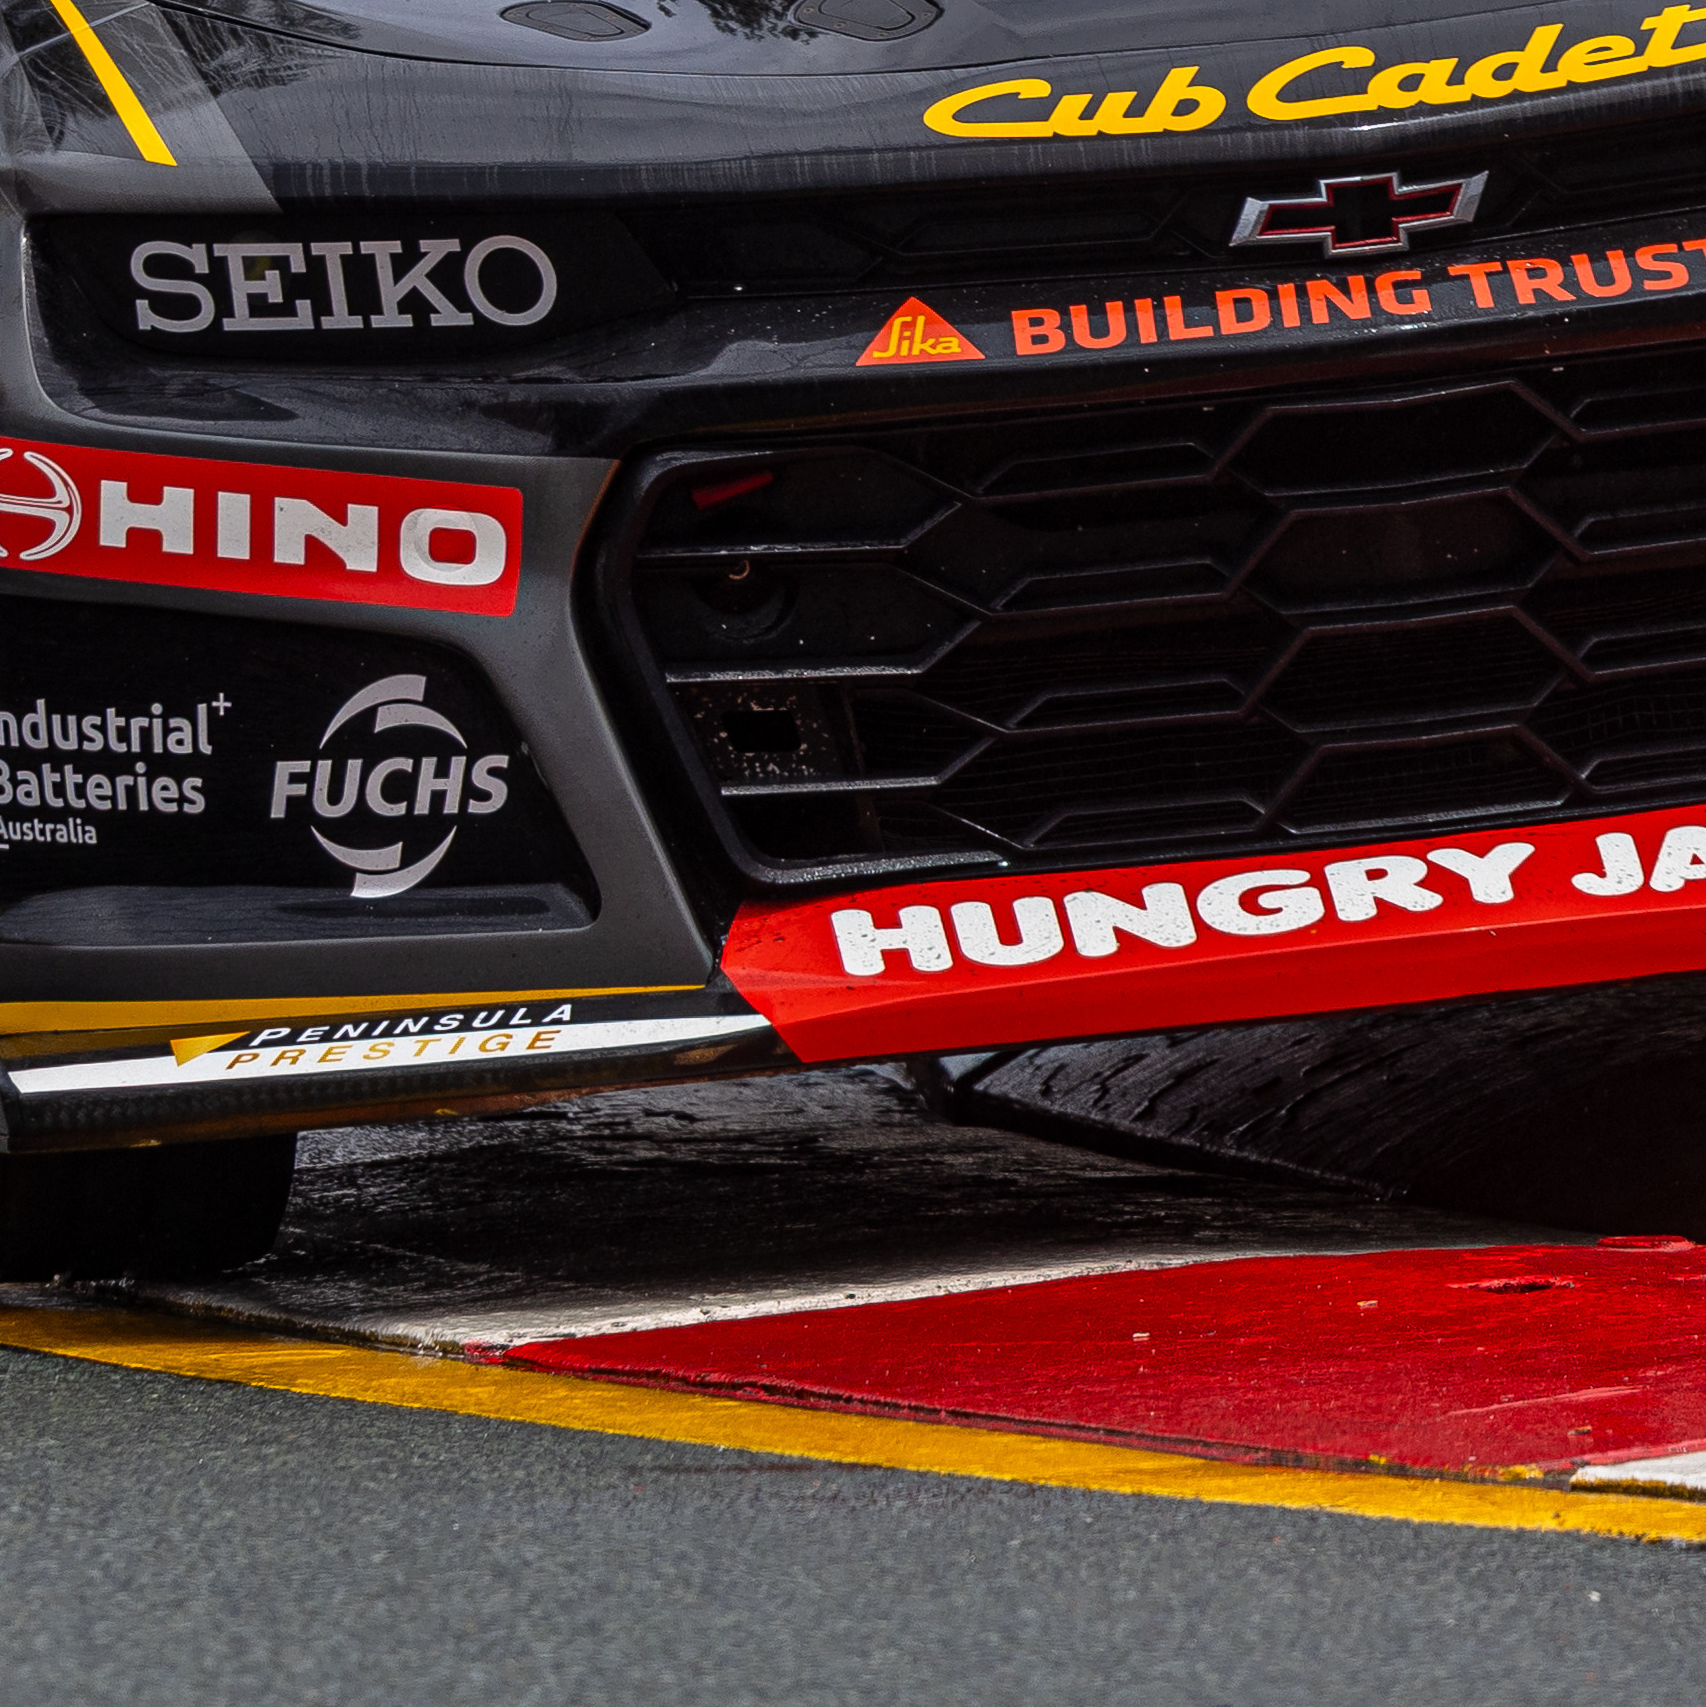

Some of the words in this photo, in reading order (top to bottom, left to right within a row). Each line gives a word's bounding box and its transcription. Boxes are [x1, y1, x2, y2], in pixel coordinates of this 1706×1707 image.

[923, 66, 1229, 140] Cub
[129, 234, 558, 333] SEIKO
[1010, 269, 1433, 358] BUILDING
[872, 315, 962, 358] Sika
[99, 478, 507, 586] HINO
[269, 754, 510, 819] FUCHS
[830, 838, 1538, 977] HUNGRY
[225, 1029, 563, 1071] PRESTIGE
[247, 1003, 574, 1048] PENINSULA
